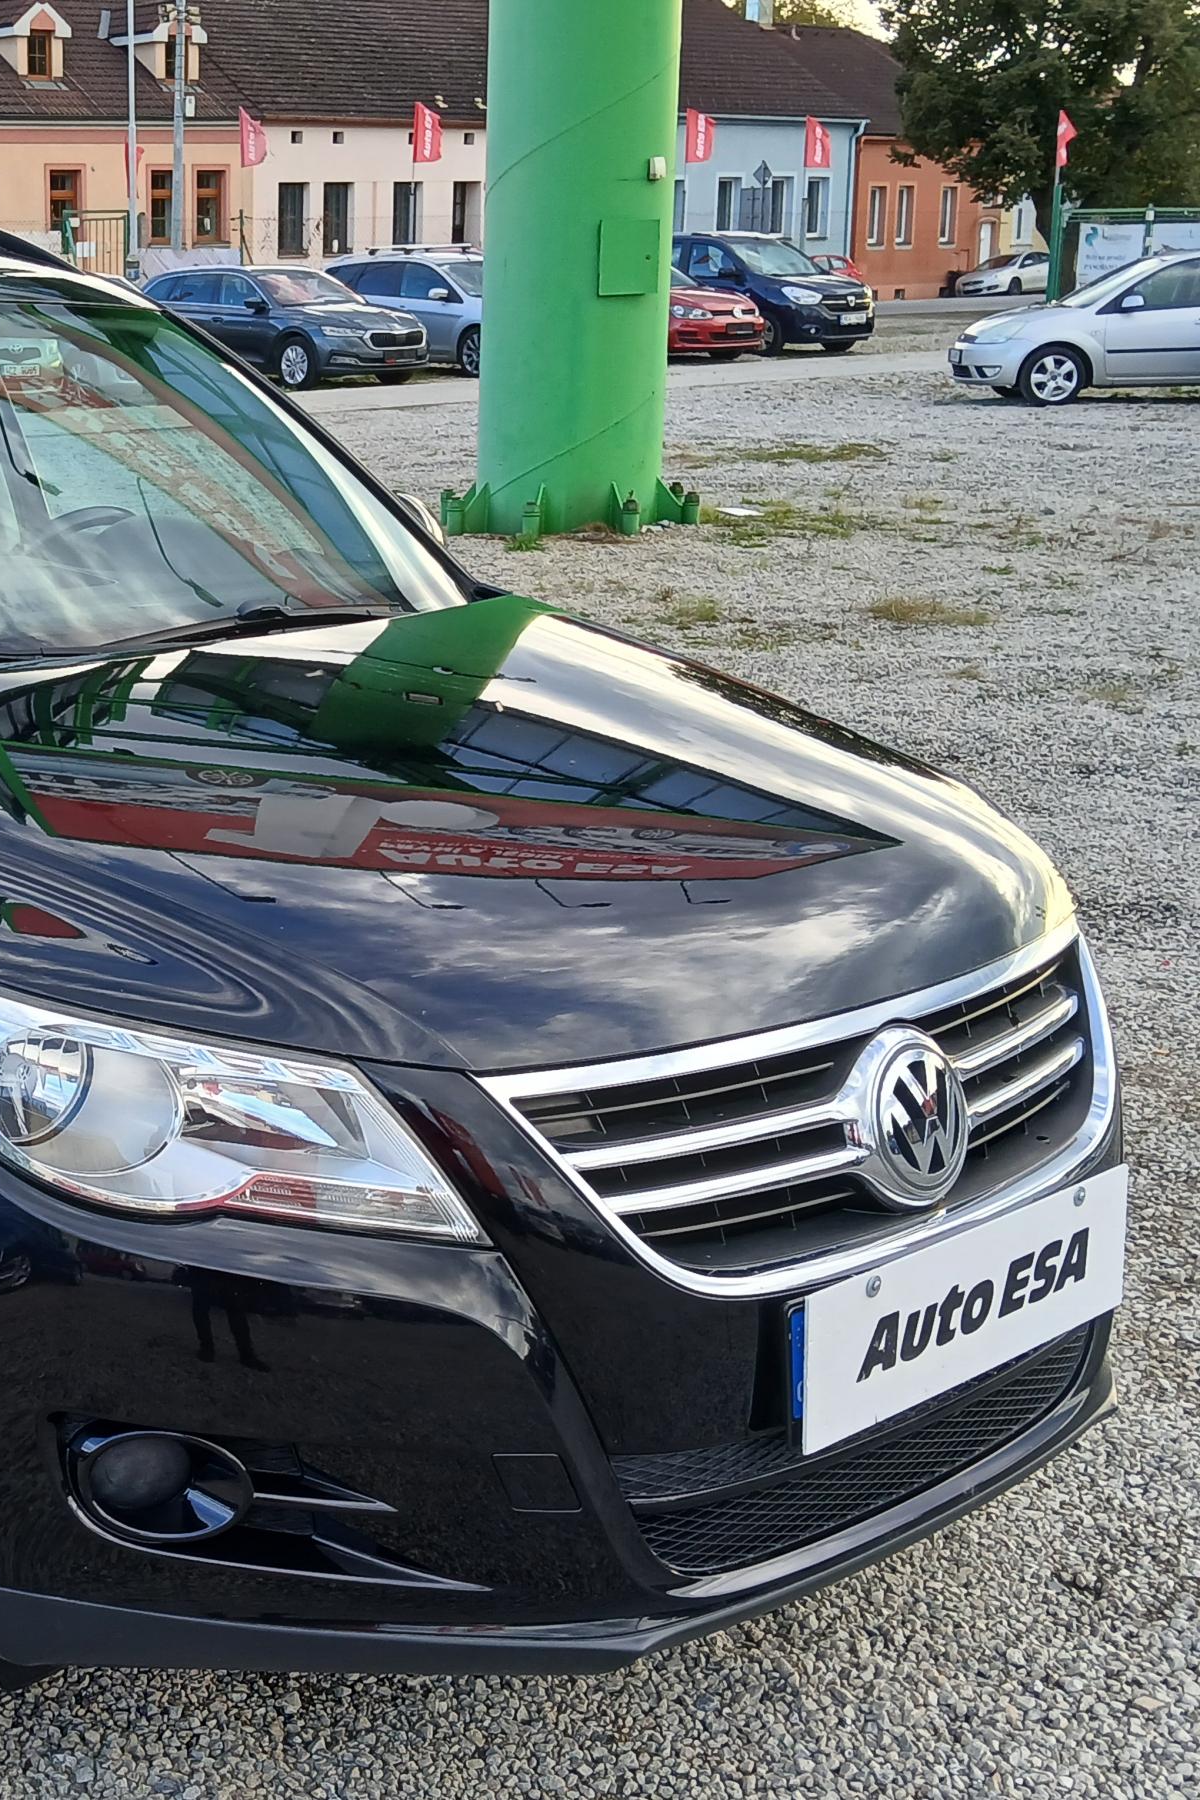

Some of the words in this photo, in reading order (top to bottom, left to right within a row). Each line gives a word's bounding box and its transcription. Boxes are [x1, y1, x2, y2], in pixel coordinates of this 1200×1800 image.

[423, 129, 433, 160] Auto
[695, 132, 705, 159] Auto
[856, 1279, 995, 1384] Auto
[997, 1226, 1090, 1319] ESA
